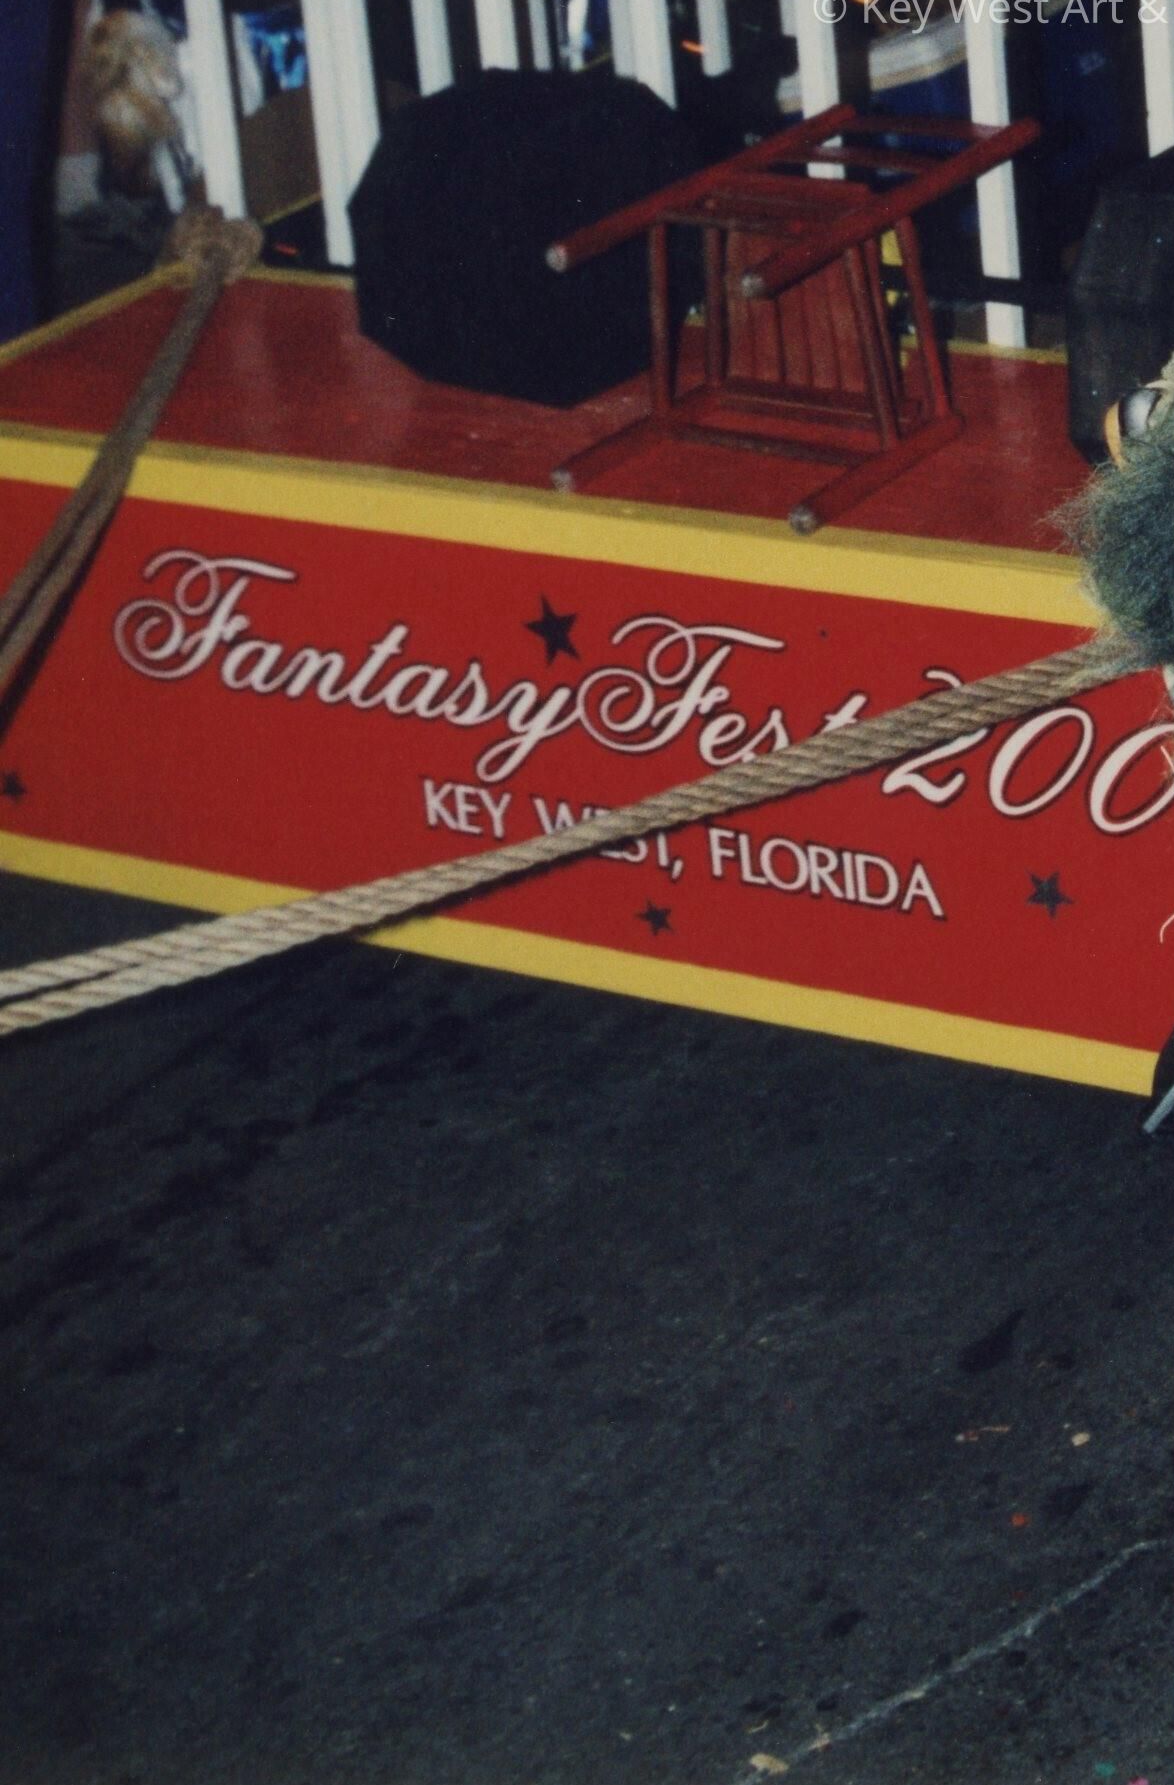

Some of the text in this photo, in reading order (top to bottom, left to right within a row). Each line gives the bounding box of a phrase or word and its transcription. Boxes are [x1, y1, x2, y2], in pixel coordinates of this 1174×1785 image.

[114, 550, 580, 783] Fantasy
[424, 779, 512, 837] KEY
[711, 827, 945, 919] FLORIDA
